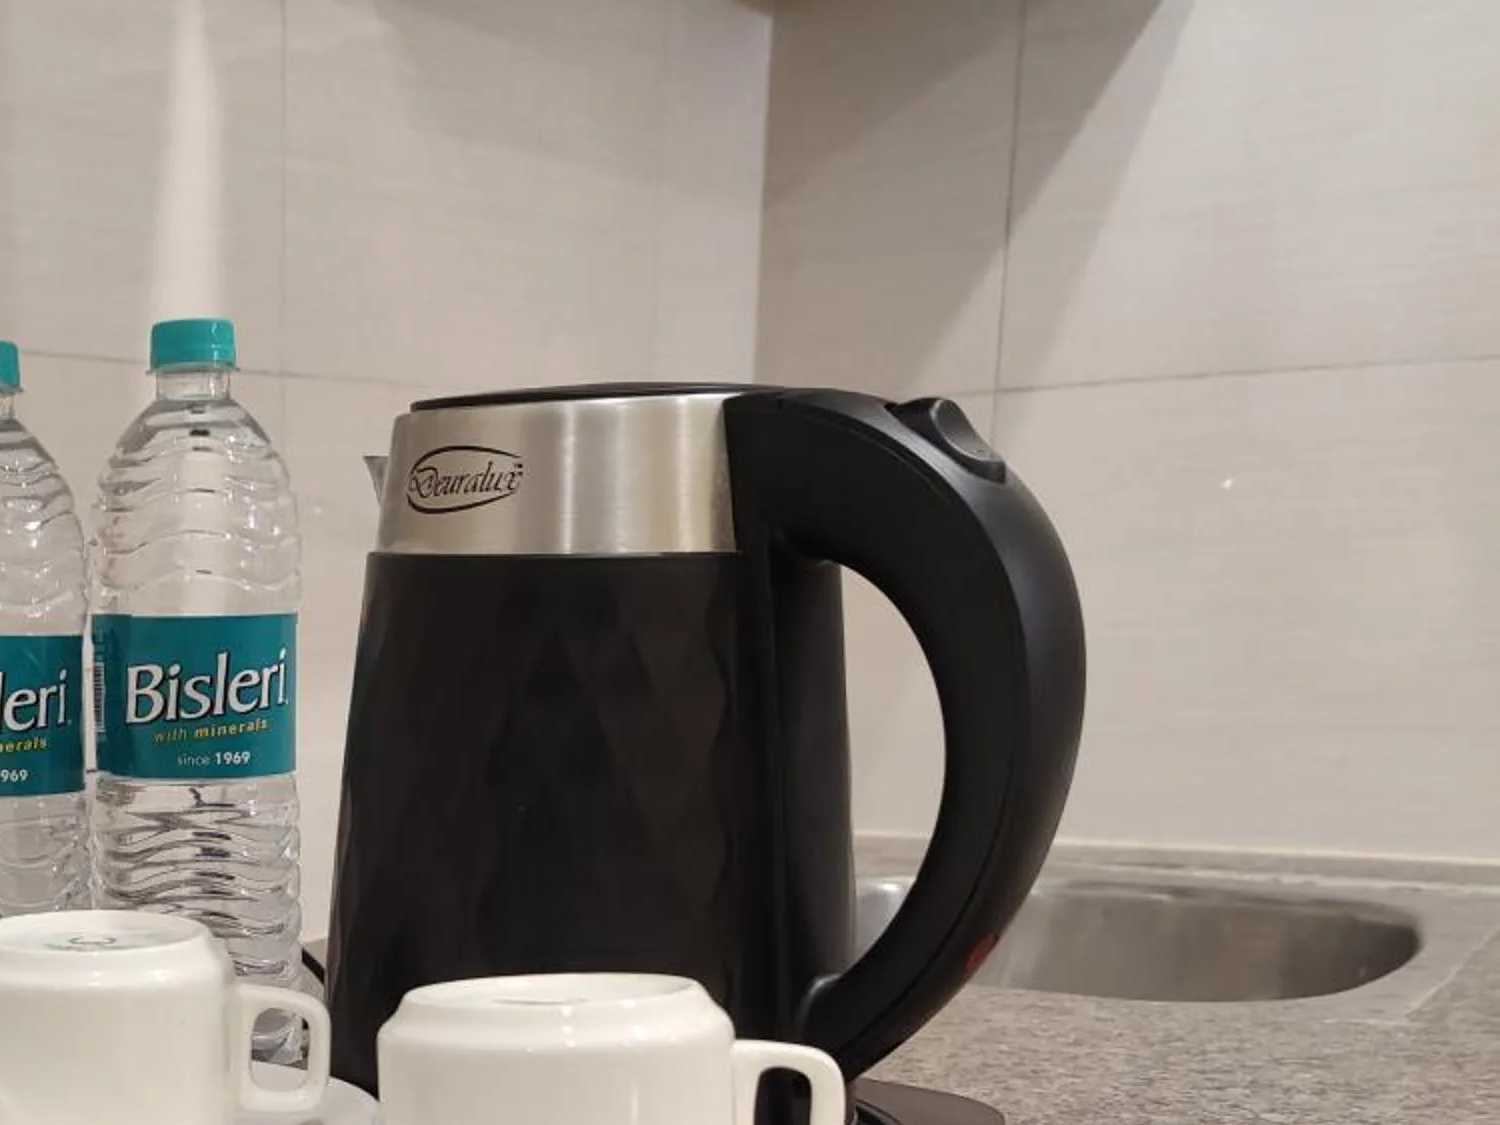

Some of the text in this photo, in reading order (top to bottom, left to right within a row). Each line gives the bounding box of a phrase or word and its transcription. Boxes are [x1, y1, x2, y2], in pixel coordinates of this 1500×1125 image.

[125, 647, 288, 725] Bisleri
[154, 718, 268, 743] with minerals
[177, 751, 251, 766] since 1969
